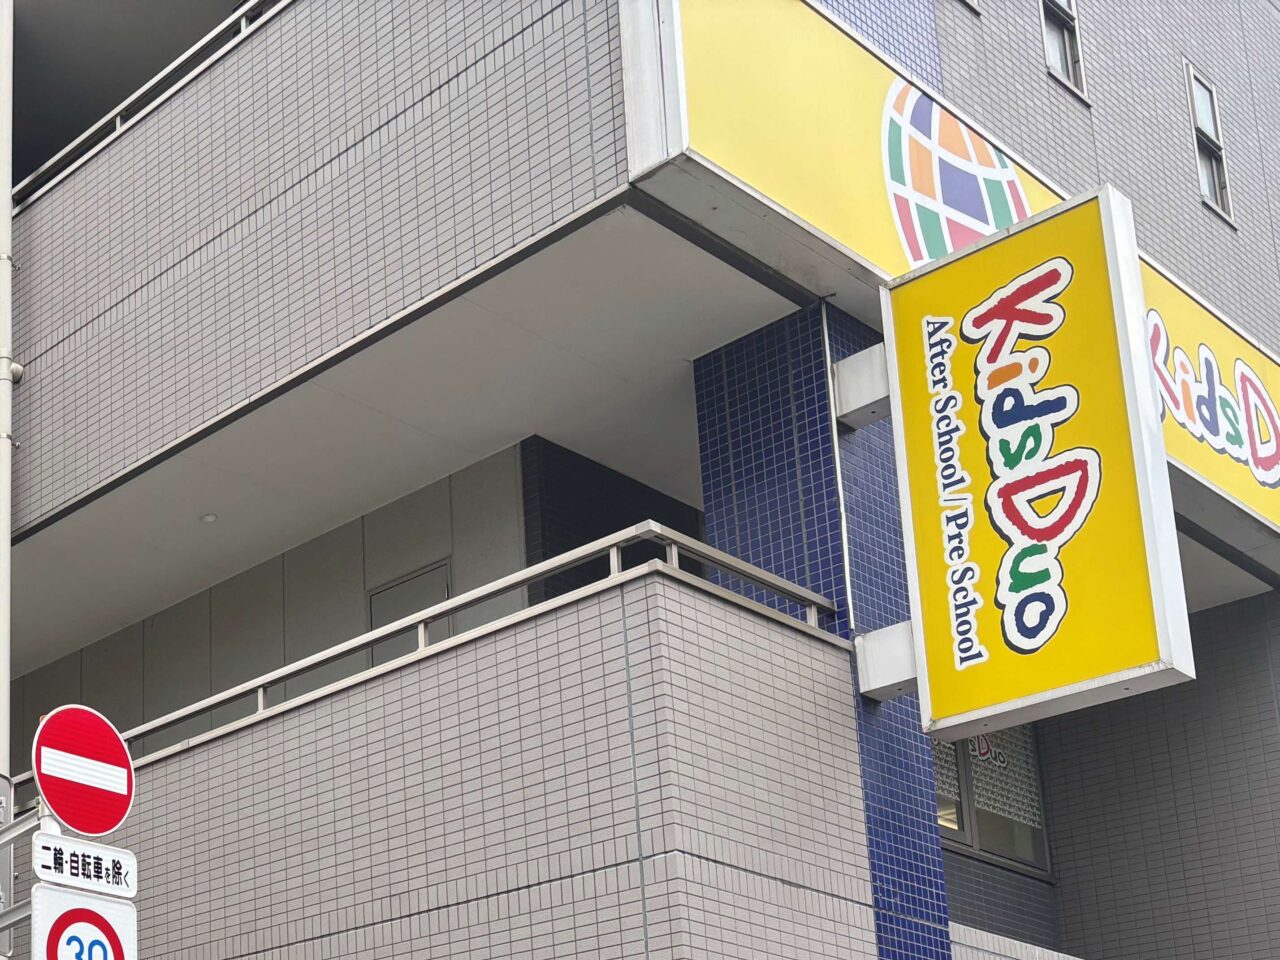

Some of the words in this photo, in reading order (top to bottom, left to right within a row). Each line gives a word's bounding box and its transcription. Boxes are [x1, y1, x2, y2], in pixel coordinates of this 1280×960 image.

[926, 320, 952, 389] After
[934, 395, 966, 492] School
[967, 262, 1094, 645] KidsDuo
[946, 507, 969, 561] Pre
[951, 566, 984, 666] School
